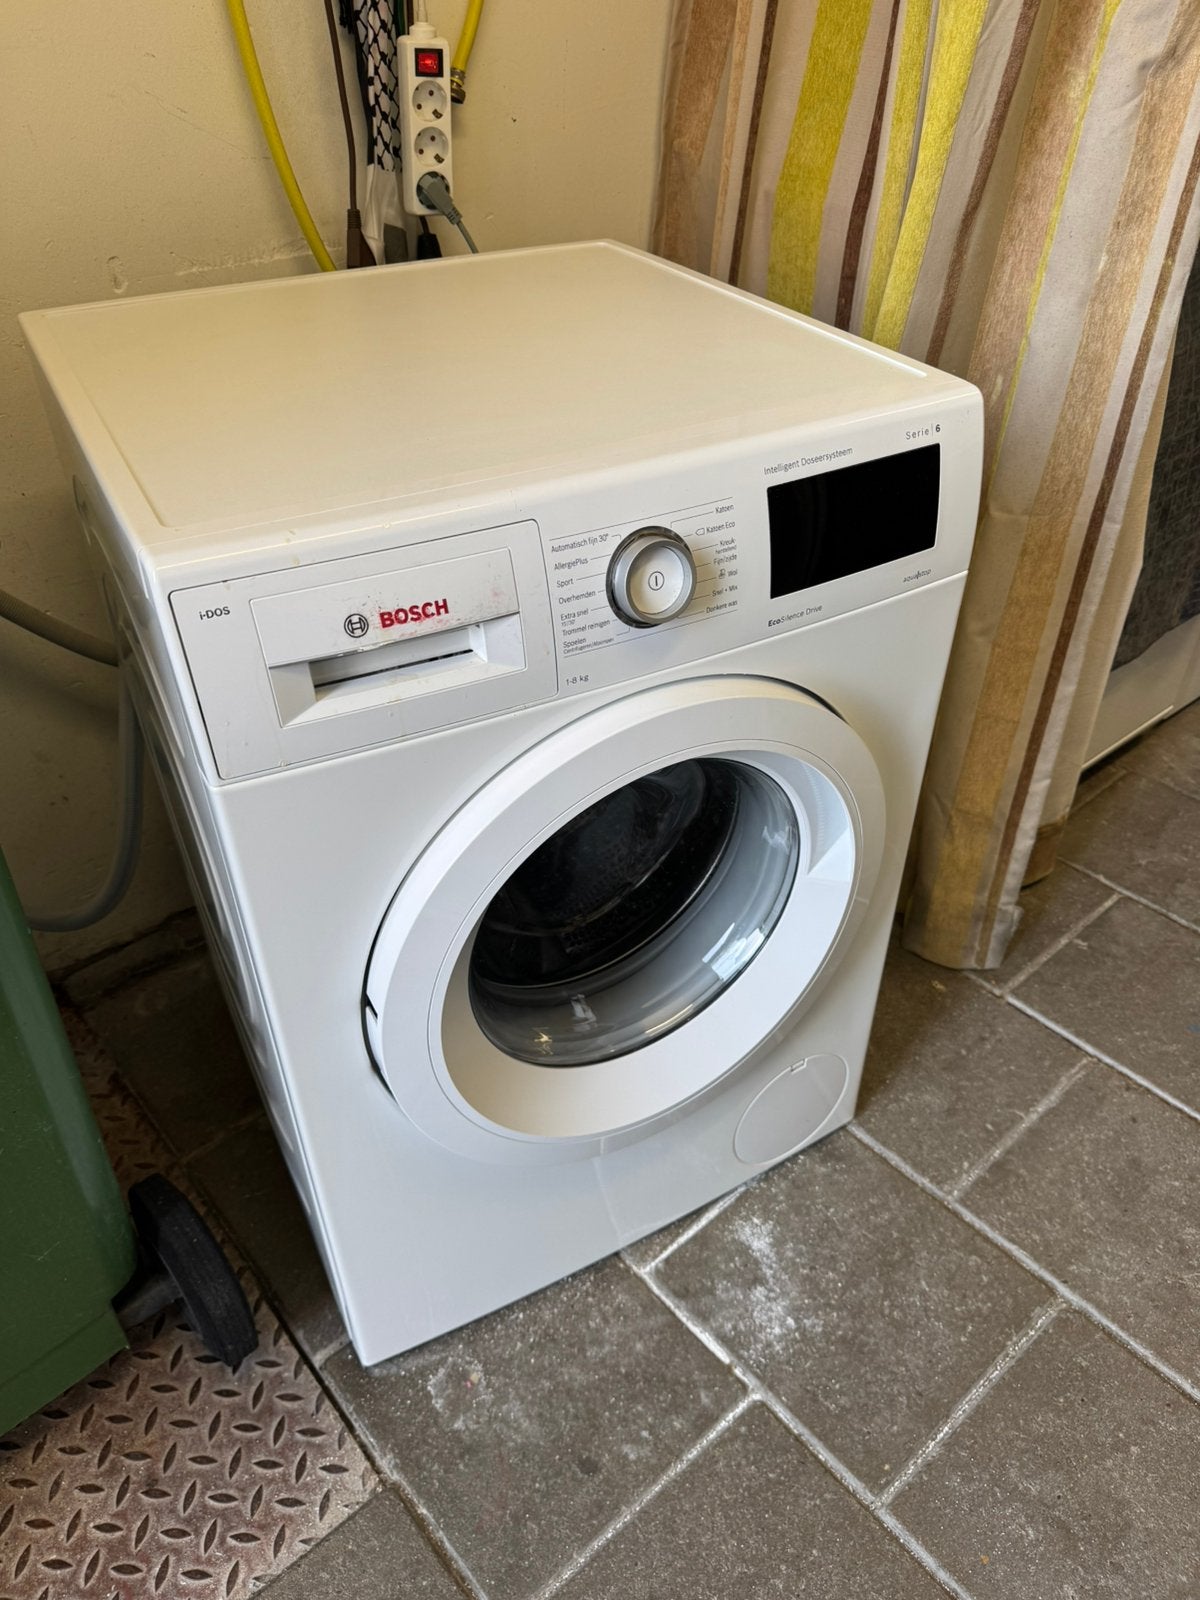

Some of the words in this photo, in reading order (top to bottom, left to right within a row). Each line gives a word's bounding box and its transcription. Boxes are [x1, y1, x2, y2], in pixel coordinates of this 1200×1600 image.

[905, 430, 930, 440] Serie
[935, 424, 941, 433] 6
[763, 460, 800, 475] Intelligent
[801, 447, 853, 466] Doseersysteem
[715, 504, 735, 514] Katoen
[706, 524, 725, 533] Katoen
[725, 521, 736, 529] Eco
[551, 540, 588, 552] Automatisch
[588, 537, 598, 545] fijn
[554, 558, 589, 570] AllergiePlus
[556, 578, 574, 588] Sport
[558, 591, 596, 604] Overhemden
[379, 598, 450, 629] BOSCH
[560, 612, 576, 621] Extra
[576, 608, 589, 617] snel
[706, 604, 728, 613] Donkere
[767, 610, 804, 627] EcoSilence
[805, 604, 823, 615] Drive
[562, 625, 587, 636] Trommel
[587, 619, 611, 630] reinigen
[563, 638, 587, 649] Spoelen
[566, 677, 578, 686] 1-8
[579, 674, 590, 682] kg
